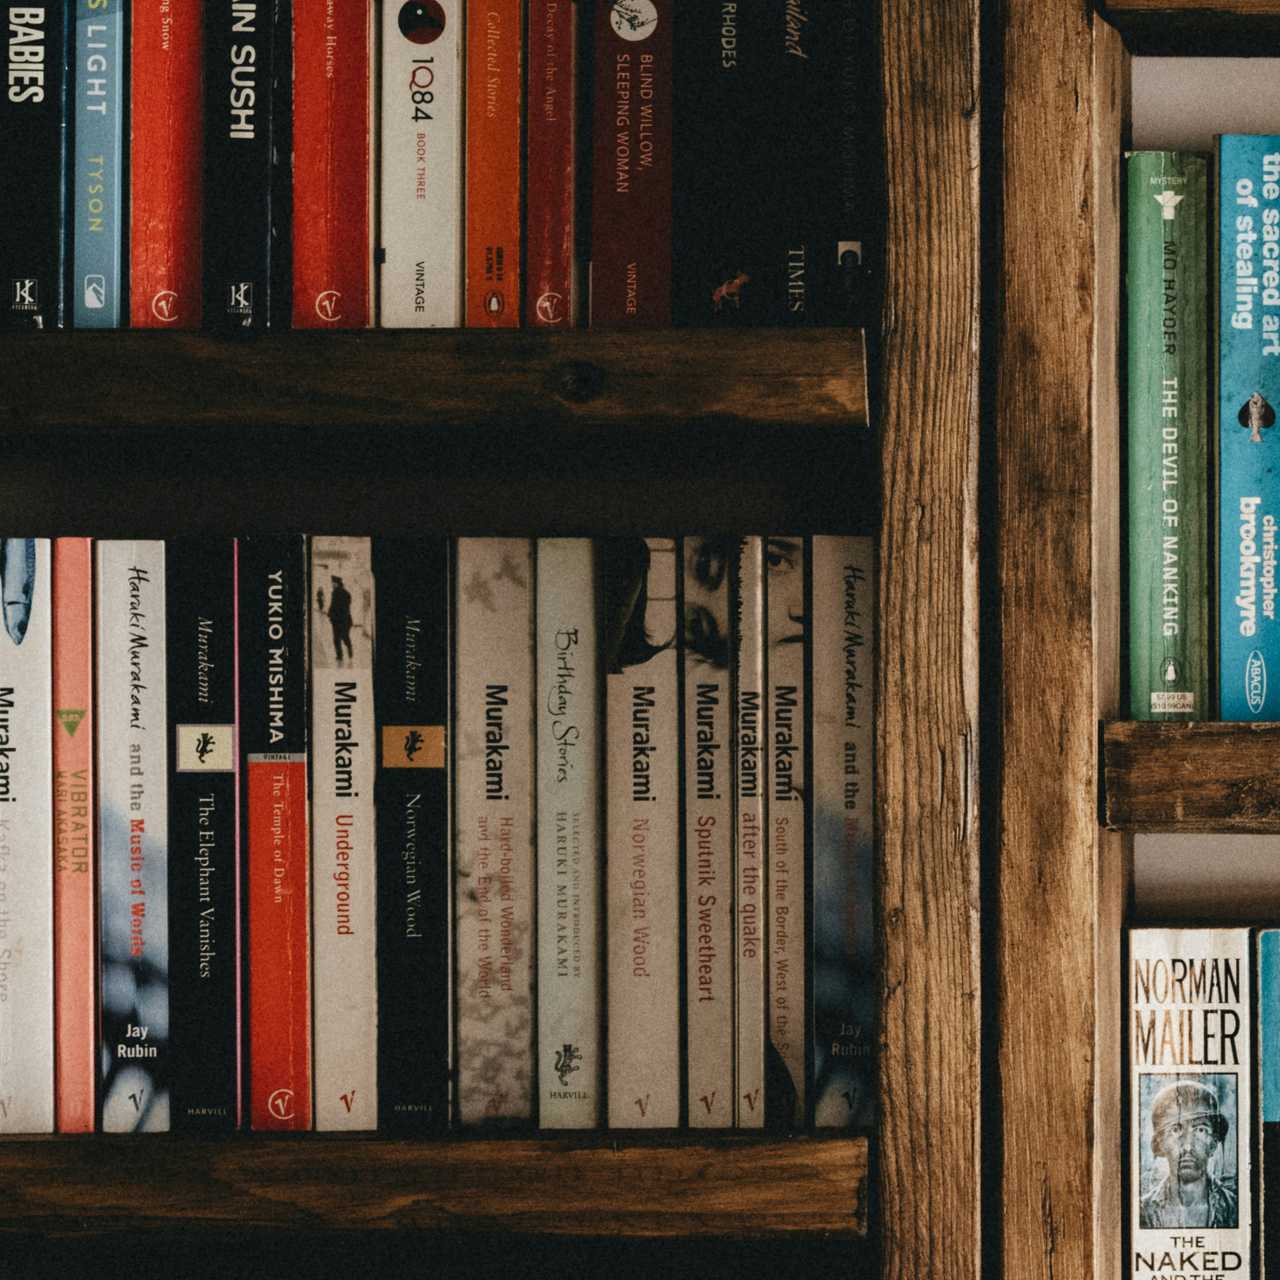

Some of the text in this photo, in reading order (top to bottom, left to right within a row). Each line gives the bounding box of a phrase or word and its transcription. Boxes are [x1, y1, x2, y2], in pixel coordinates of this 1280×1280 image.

[8, 7, 44, 102] BABIES
[230, 45, 256, 139] SUSHI
[87, 25, 106, 231] LIGHT TYSON
[410, 57, 434, 199] 1Q84 BOOK THREE
[415, 261, 425, 312] VINTAGE
[1232, 179, 1257, 329] of stealing
[1239, 496, 1261, 636] brookmyre
[1261, 515, 1278, 619] christopher
[268, 571, 284, 744] YUKIO MISHIMA
[1250, 659, 1262, 705] ABACUS
[270, 773, 285, 903] The Temple of Dawn
[334, 681, 357, 936] Murakami Underground
[194, 793, 215, 978] The Elephant Vanishes
[124, 1024, 149, 1036] Jay
[1134, 959, 1240, 1003] NORMAN
[116, 1044, 157, 1058] Rubin
[1136, 1010, 1240, 1065] MAILER
